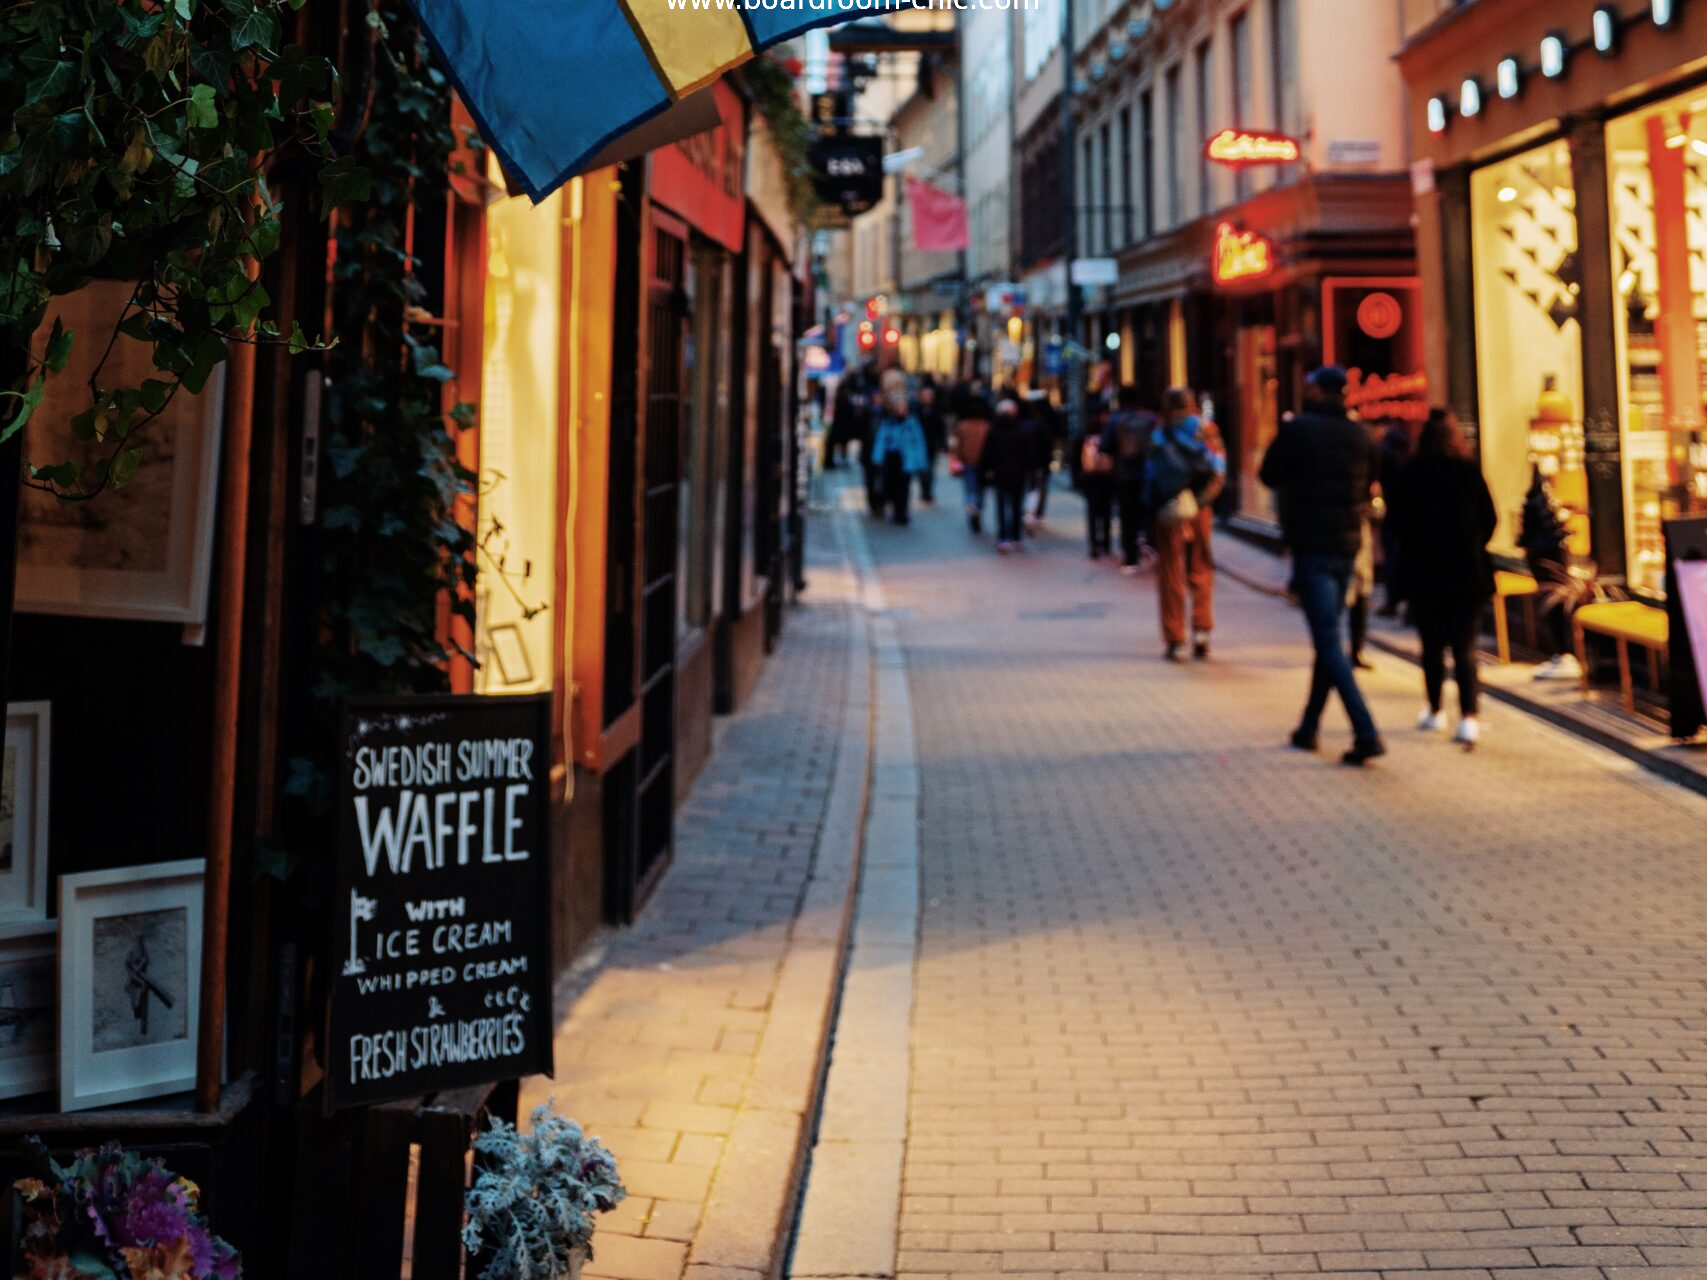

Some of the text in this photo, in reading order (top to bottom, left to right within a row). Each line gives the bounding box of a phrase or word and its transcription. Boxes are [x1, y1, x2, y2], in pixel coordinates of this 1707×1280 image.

[353, 738, 533, 788] SWEDISH SUMMER
[354, 784, 529, 877] WAFFLE
[405, 896, 465, 920] WITH
[377, 920, 511, 959] ICE CREAM
[357, 956, 527, 996] WHIPPED CREAM
[428, 996, 446, 1019] &
[350, 1014, 524, 1084] FRESH STRAWBERRIES
